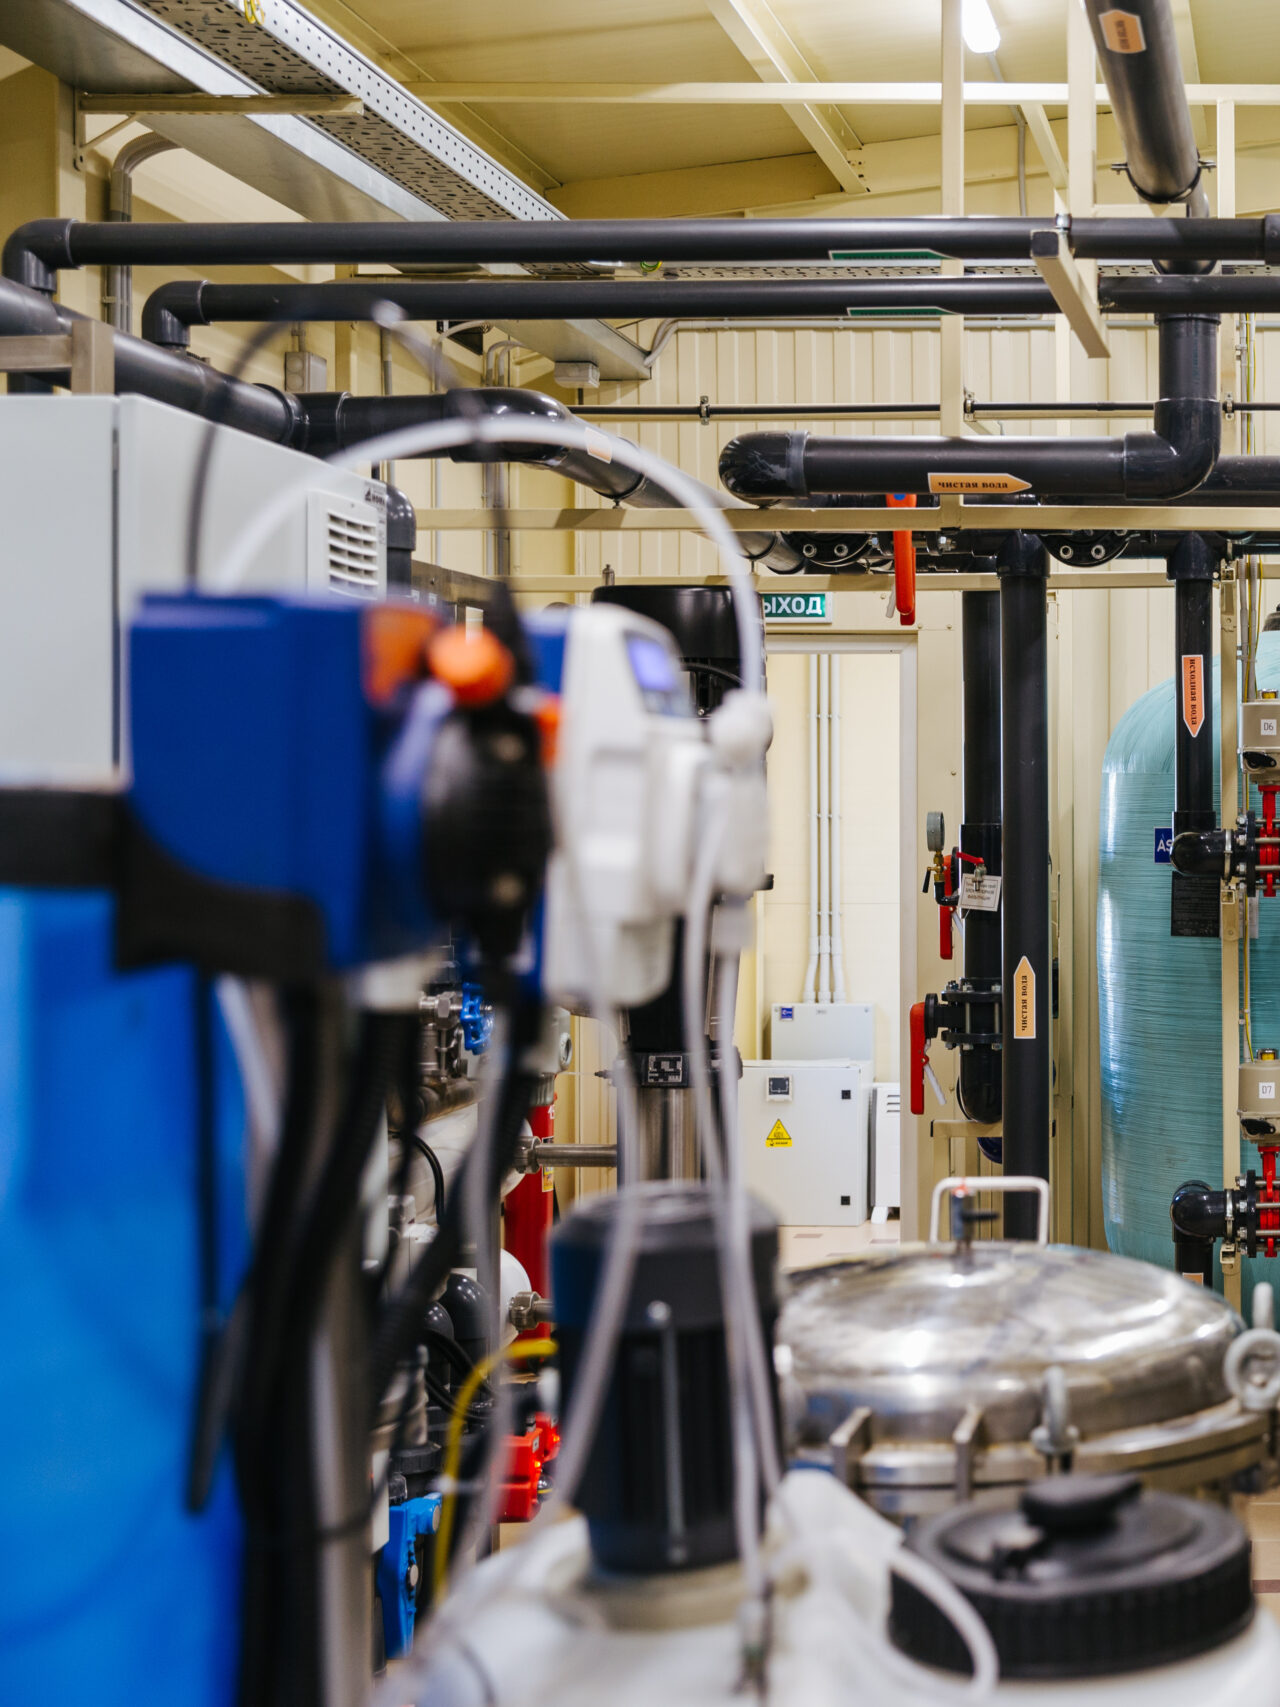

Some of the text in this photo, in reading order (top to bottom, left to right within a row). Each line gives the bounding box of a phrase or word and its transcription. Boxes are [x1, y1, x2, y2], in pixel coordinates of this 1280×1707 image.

[938, 481, 1008, 490] чистая вода
[1189, 659, 1197, 702] исходная
[1263, 722, 1274, 731] D6
[1261, 1085, 1272, 1094] D7
